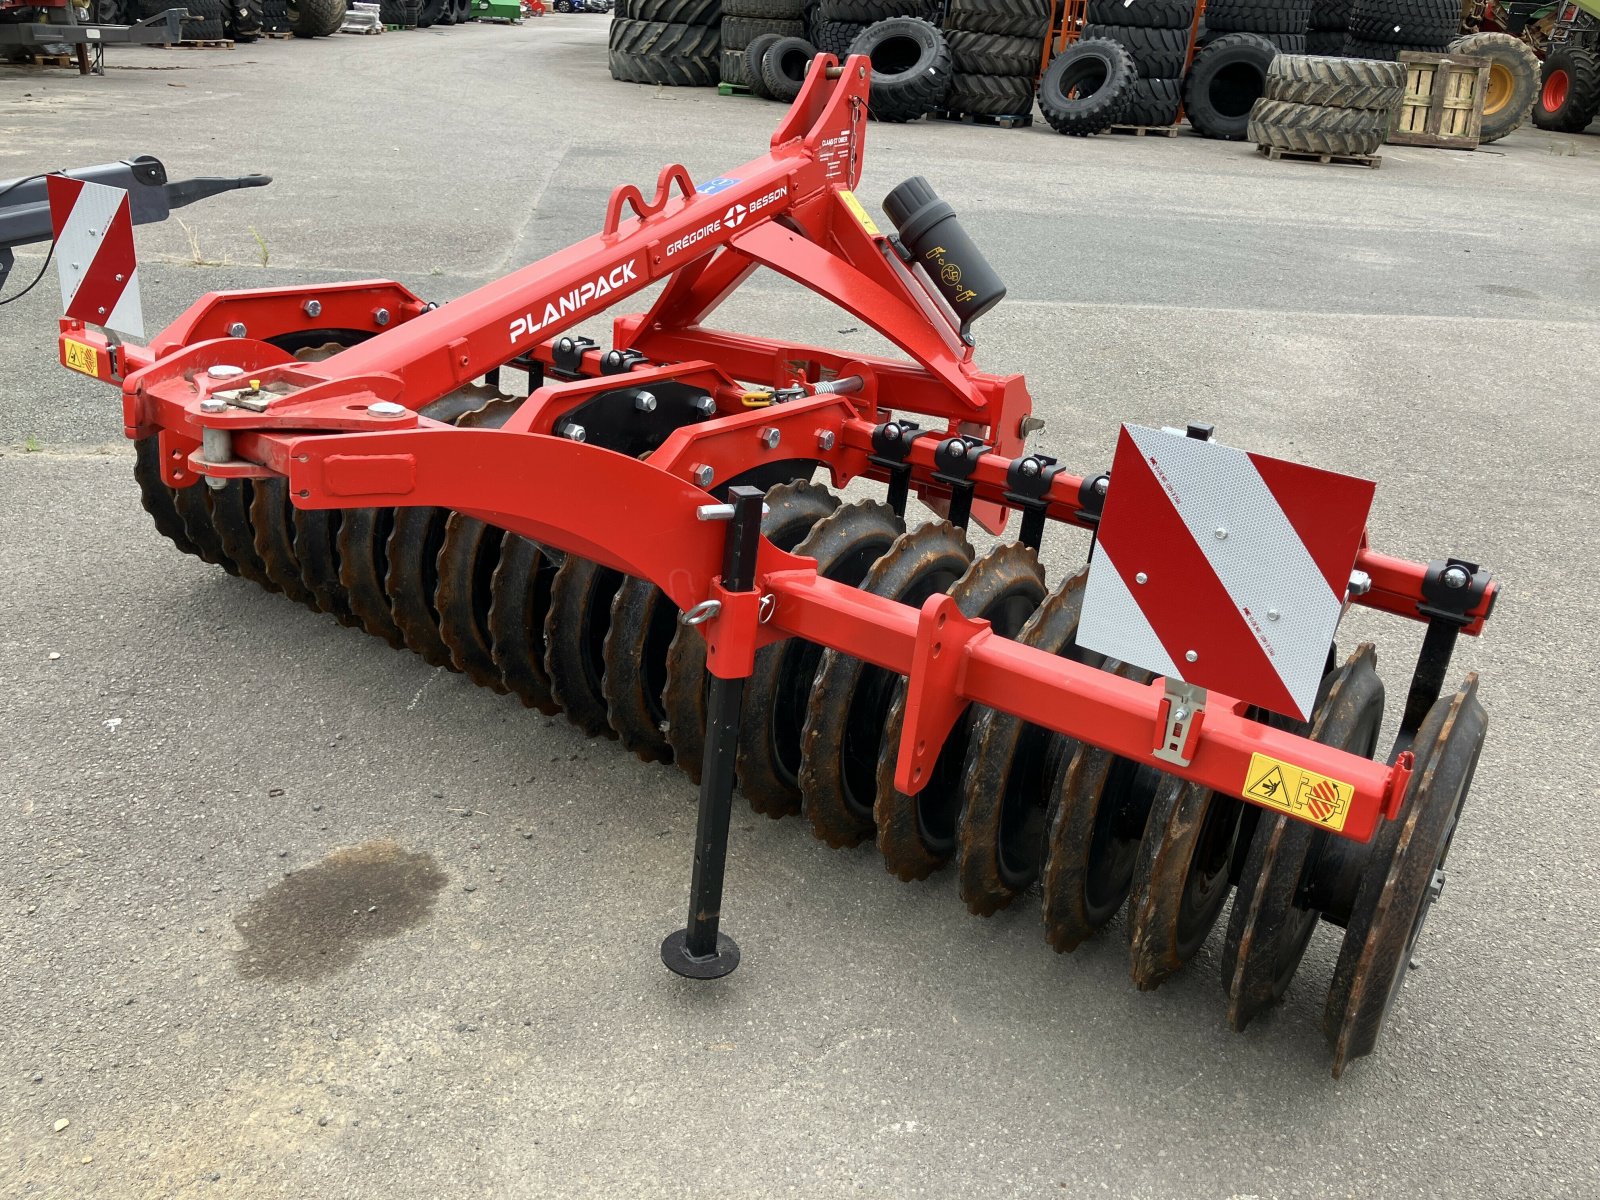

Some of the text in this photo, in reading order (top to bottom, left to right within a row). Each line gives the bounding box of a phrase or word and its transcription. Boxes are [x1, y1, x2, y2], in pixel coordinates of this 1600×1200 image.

[666, 185, 788, 257] GRÉGOIRE BESSON
[509, 259, 638, 344] PLANIPACK
